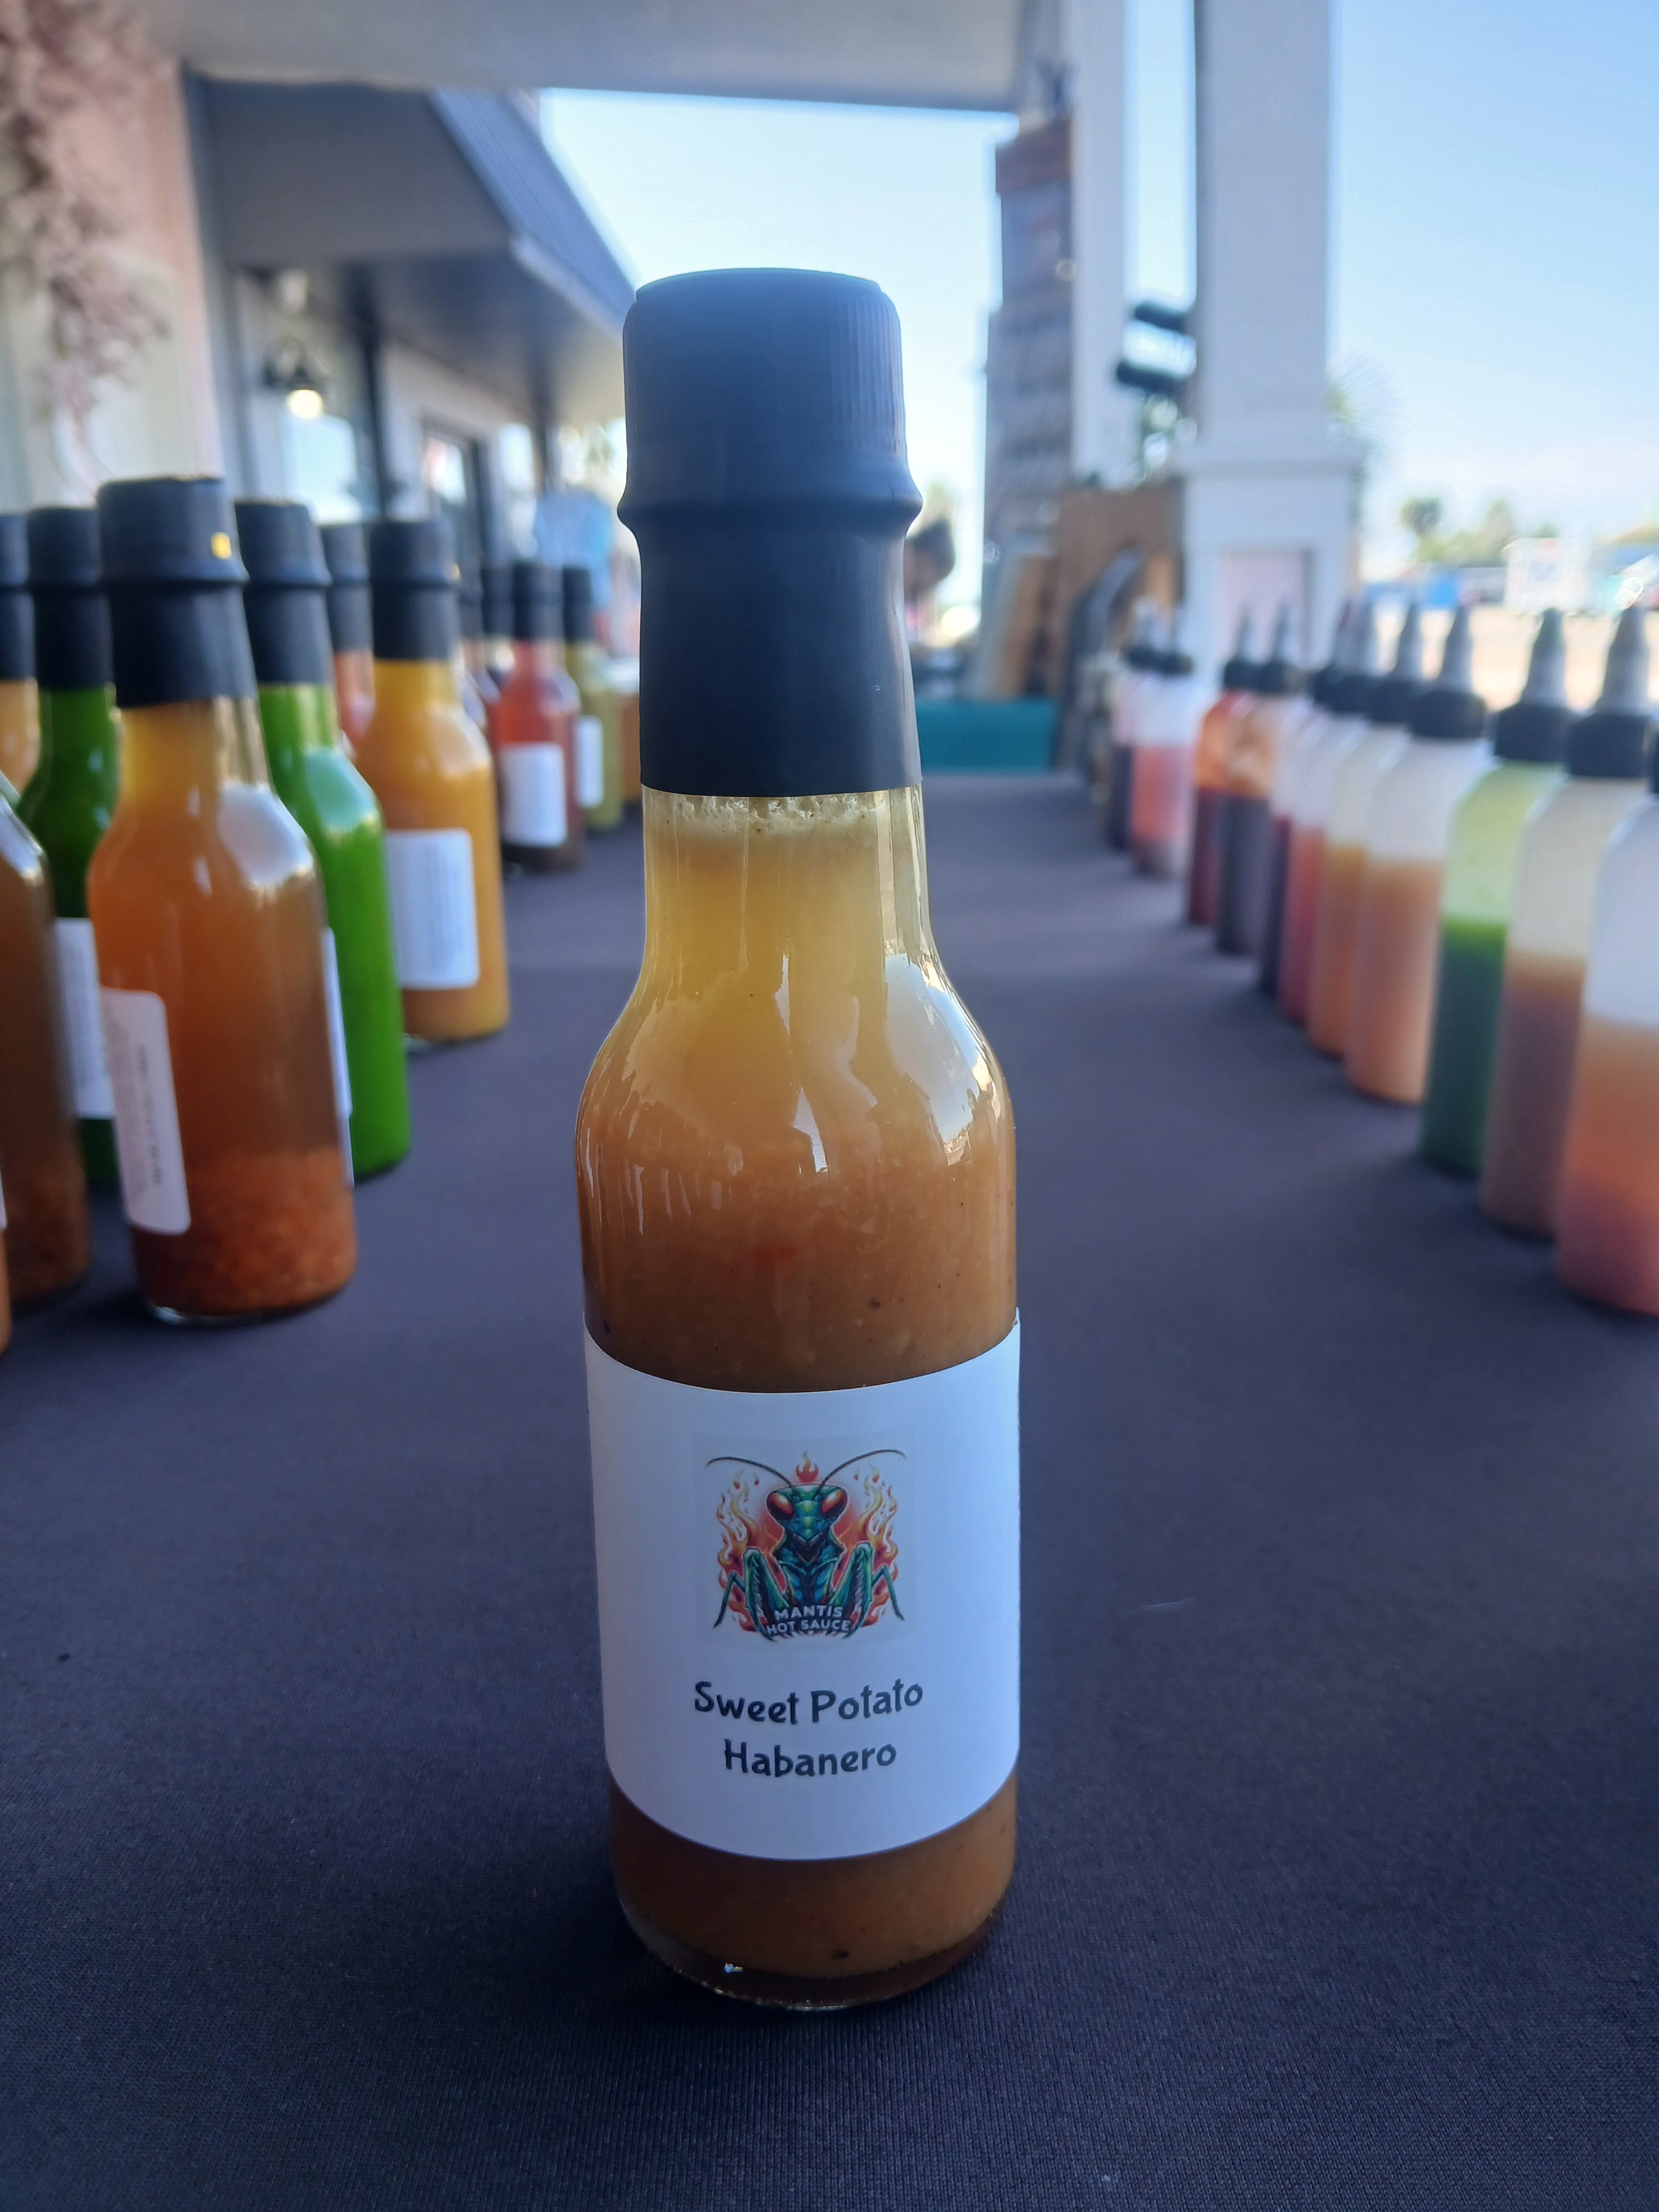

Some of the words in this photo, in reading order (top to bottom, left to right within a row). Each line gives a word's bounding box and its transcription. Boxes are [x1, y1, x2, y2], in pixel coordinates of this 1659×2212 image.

[767, 1621, 796, 1635] HOT
[800, 1619, 852, 1631] SAUCE
[774, 1605, 844, 1621] MANTIS
[695, 1681, 799, 1725] Sweet
[811, 1679, 923, 1722] Potato
[724, 1738, 897, 1778] Habanero
